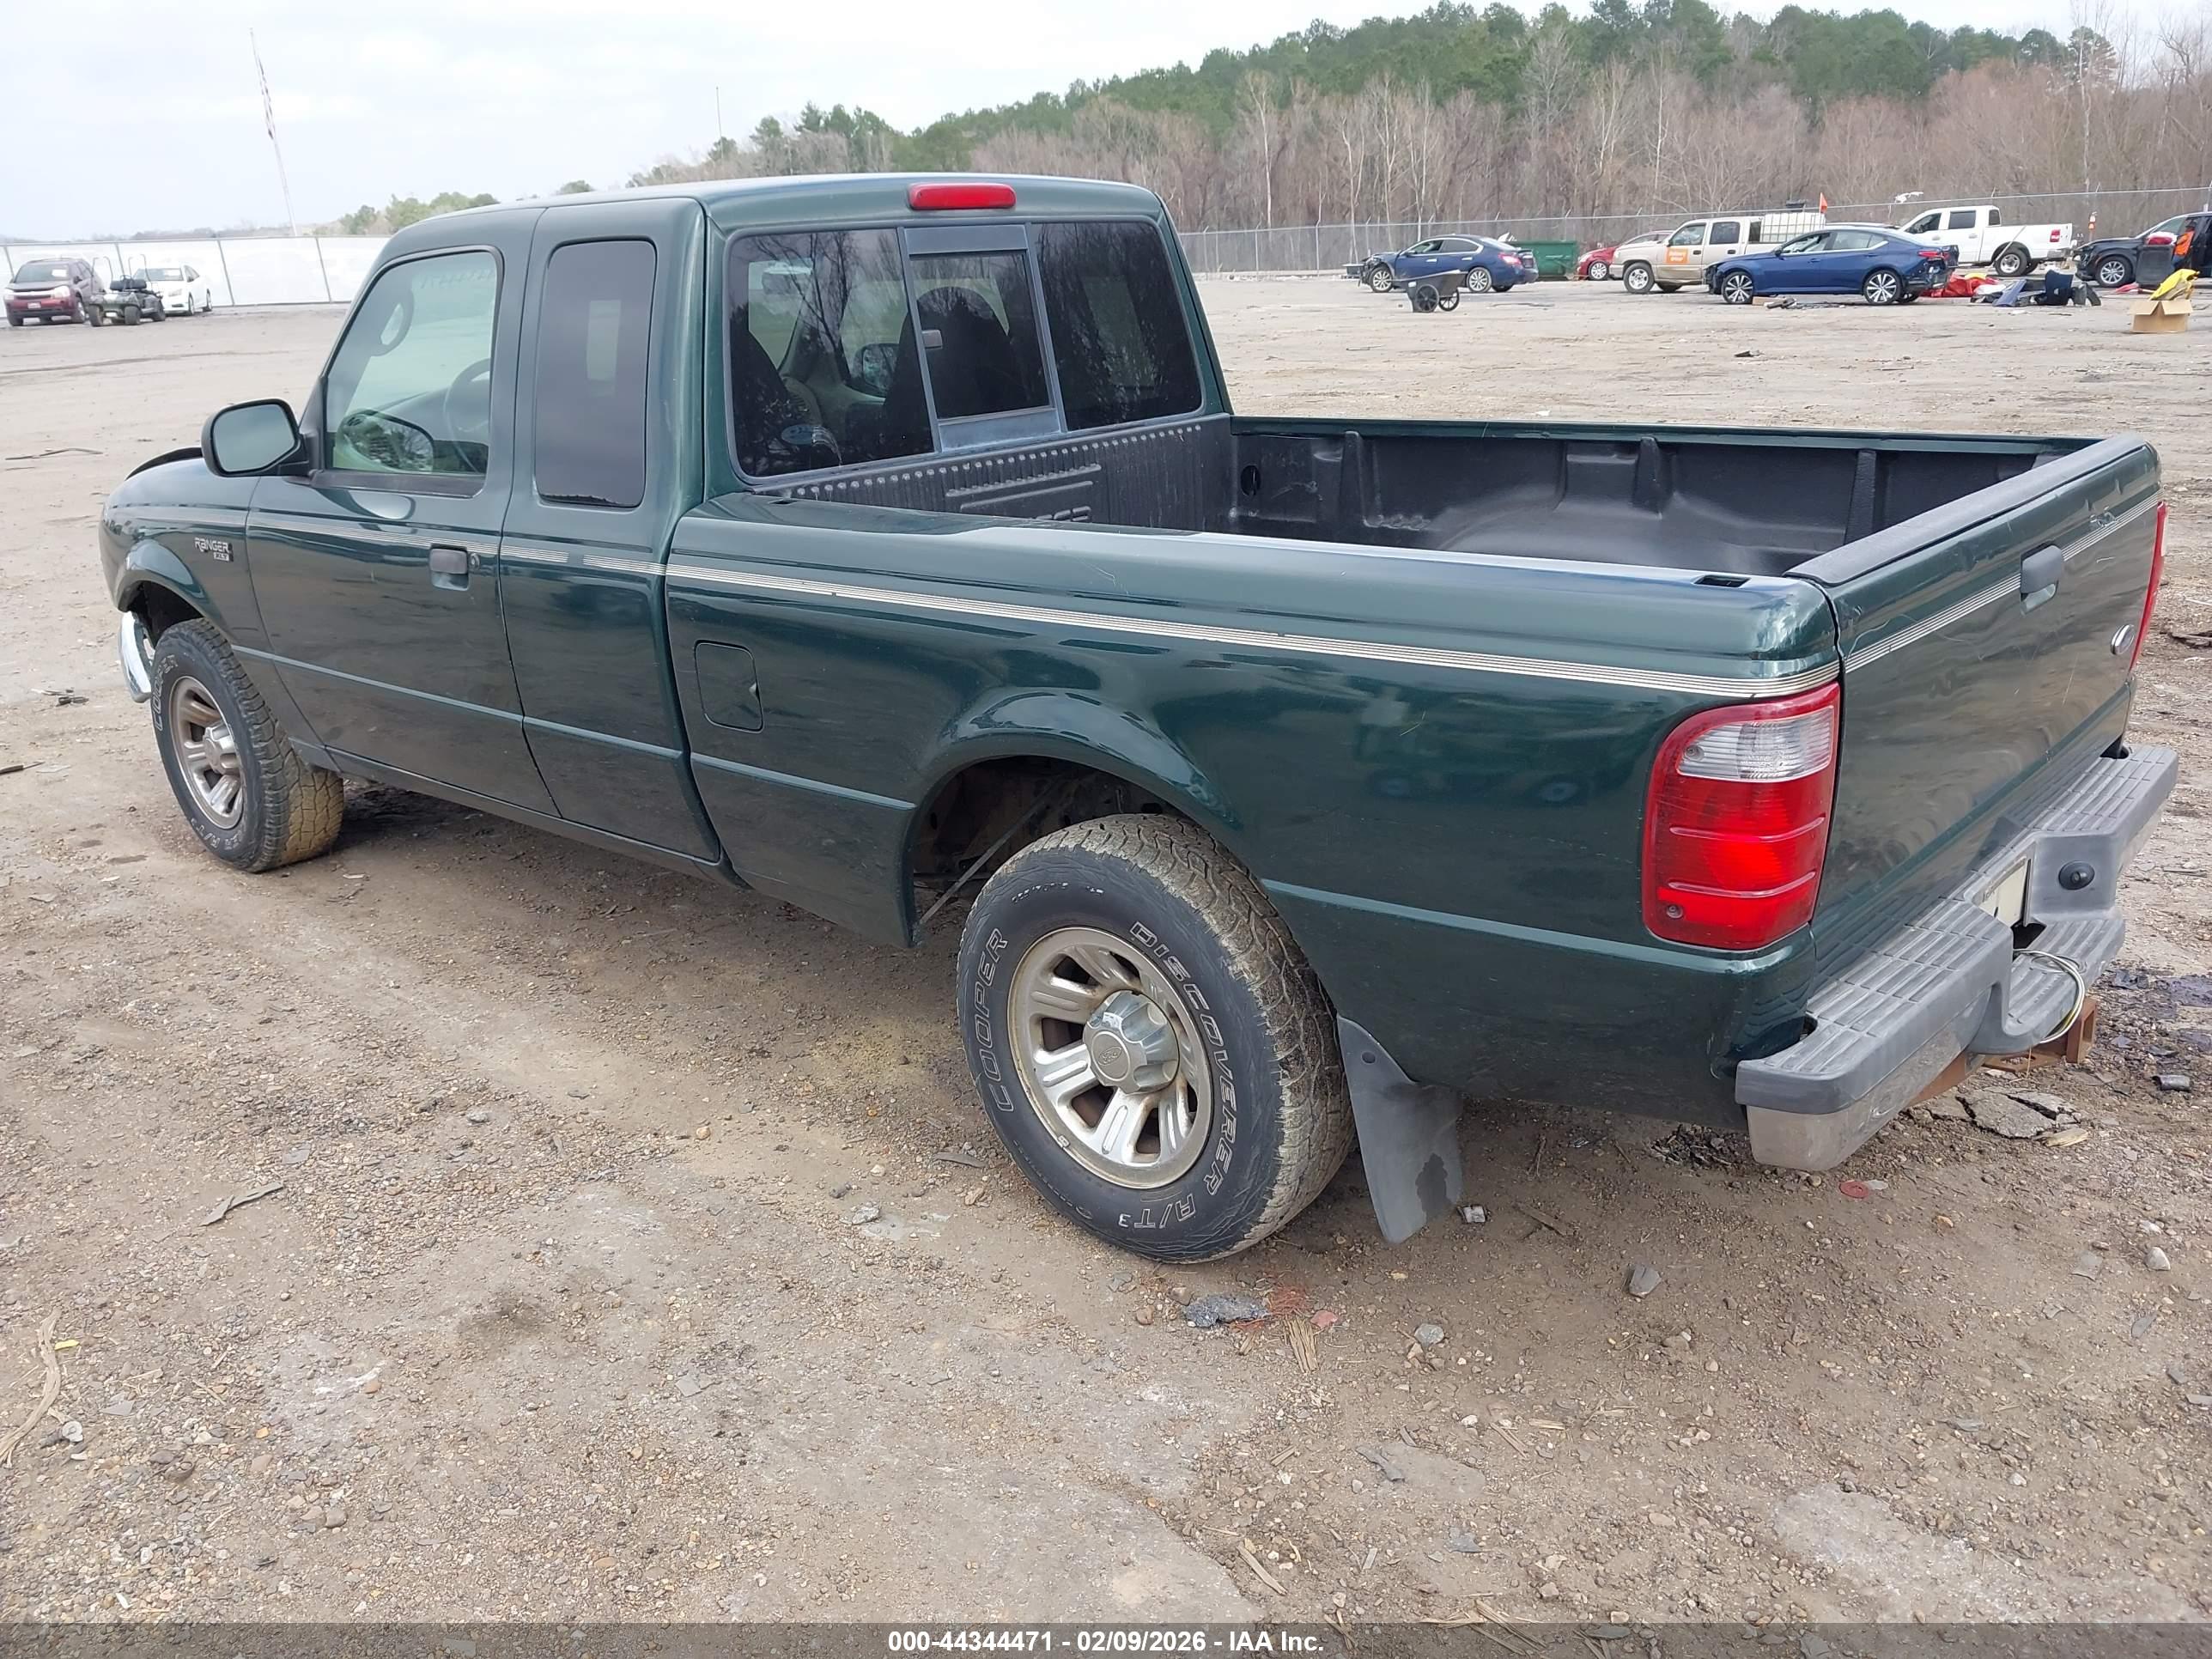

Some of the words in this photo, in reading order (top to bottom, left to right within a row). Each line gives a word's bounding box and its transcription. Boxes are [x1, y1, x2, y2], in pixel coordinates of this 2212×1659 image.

[194, 537, 231, 554] RANGER
[971, 927, 1013, 1113] COOPER
[1129, 921, 1238, 1196] DISCOVERER
